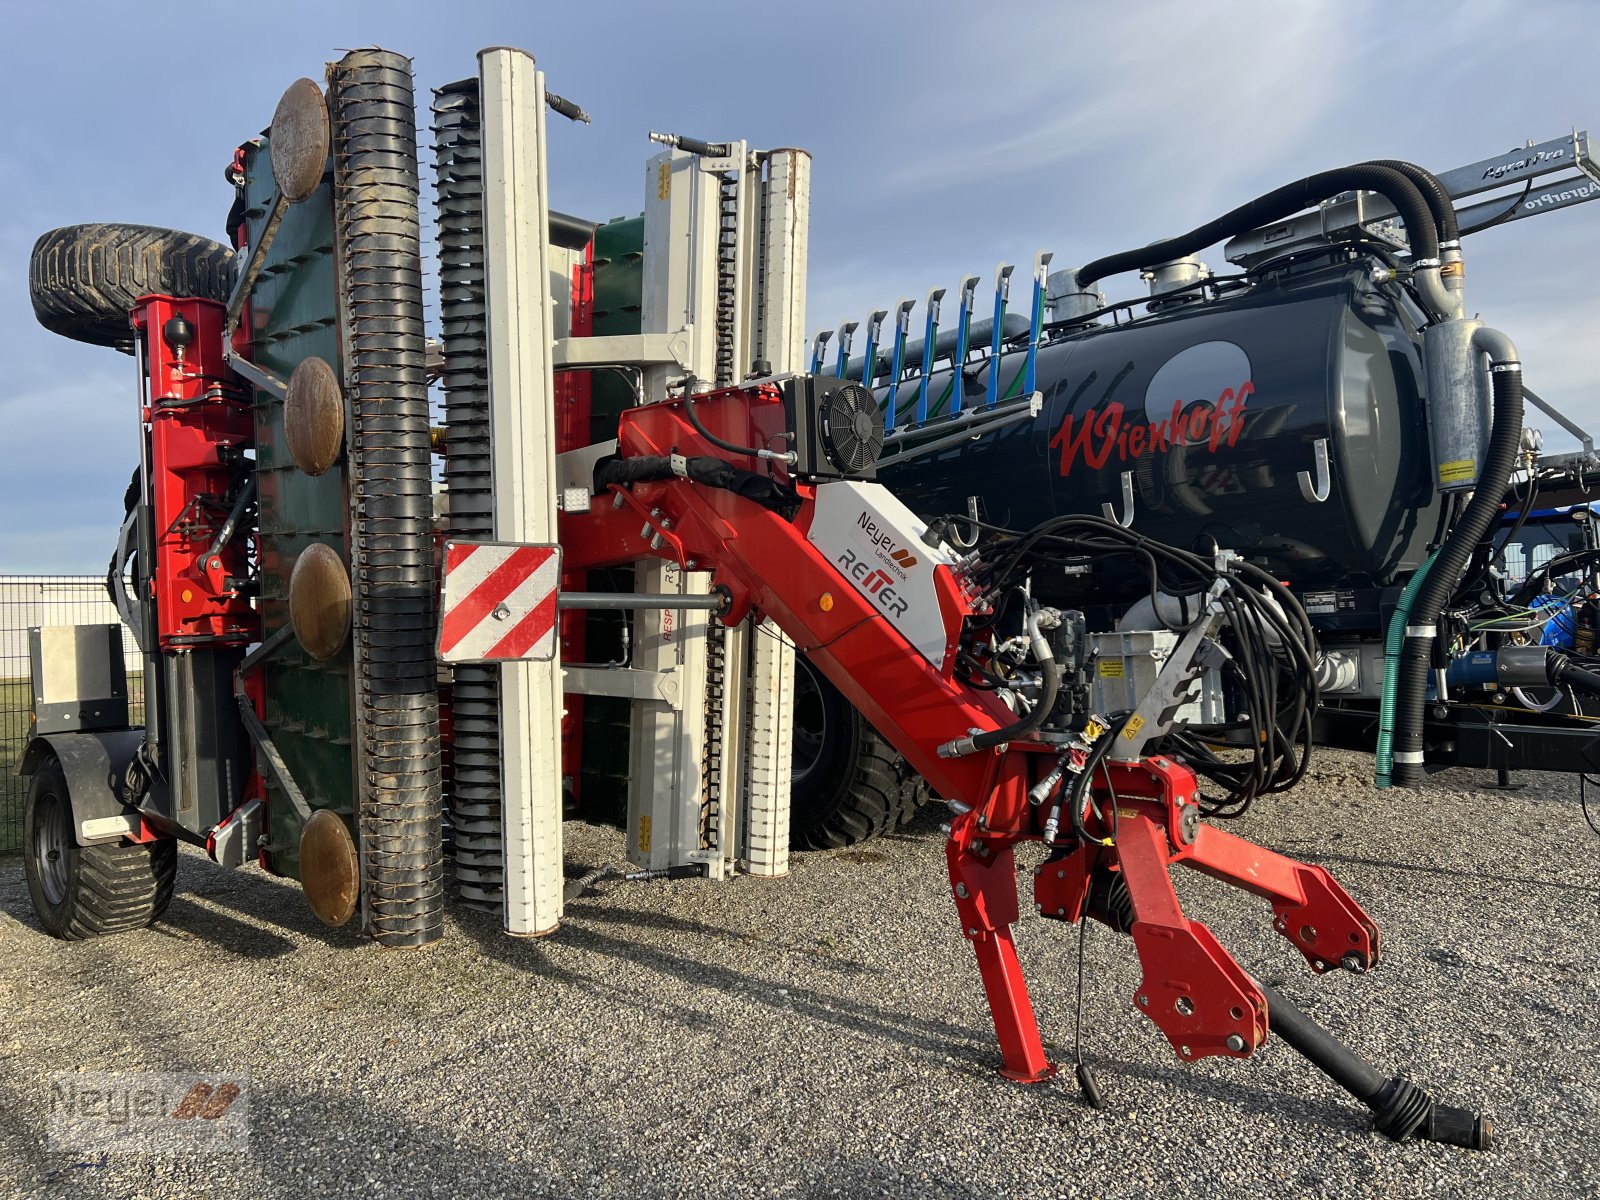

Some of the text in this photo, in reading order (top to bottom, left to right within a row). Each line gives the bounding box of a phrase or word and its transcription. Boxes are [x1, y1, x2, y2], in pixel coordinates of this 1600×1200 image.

[1050, 381, 1255, 477] Wienhoff
[857, 511, 896, 553] Neyer
[838, 549, 909, 619] REITER
[875, 548, 908, 582] Landtechnik
[663, 609, 673, 641] RESP
